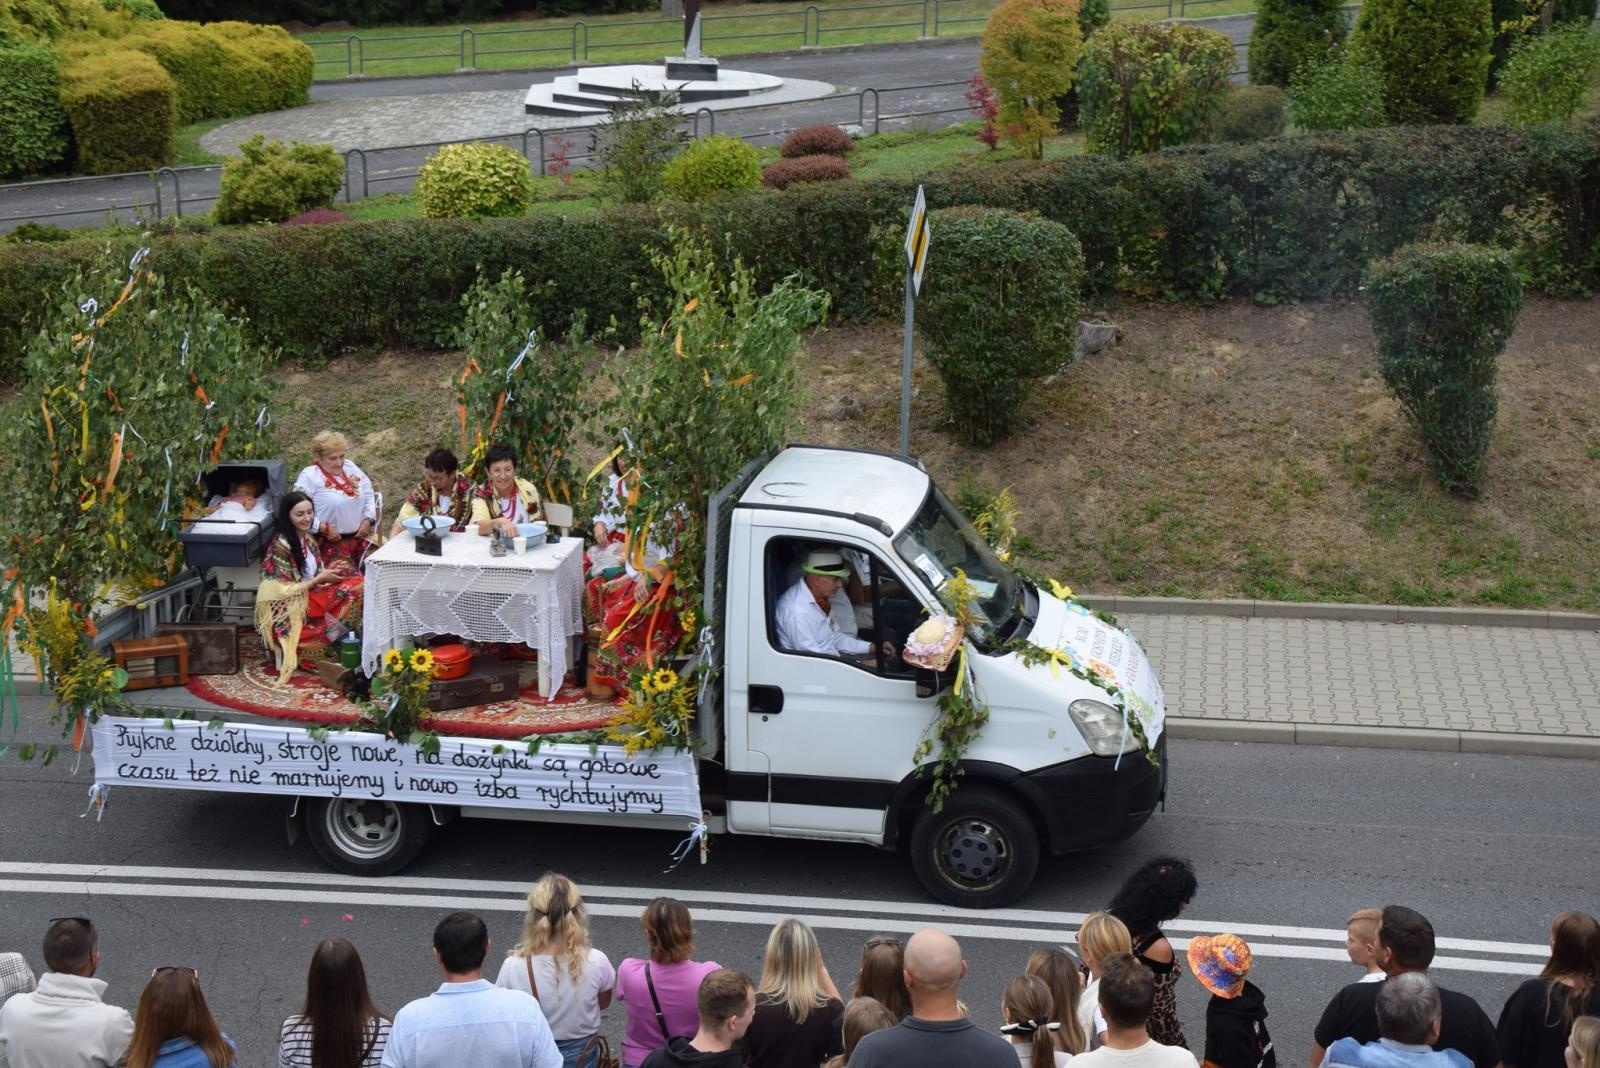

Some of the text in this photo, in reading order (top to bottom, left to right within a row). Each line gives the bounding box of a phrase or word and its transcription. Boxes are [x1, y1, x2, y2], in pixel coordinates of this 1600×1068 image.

[191, 727, 273, 765] dziołchy,
[278, 732, 342, 771] stroje
[351, 741, 404, 766] nowe,
[415, 746, 444, 765] na
[452, 743, 532, 778] dożynki
[542, 757, 569, 778] są
[579, 752, 661, 780] gotowe
[117, 759, 664, 813] czasu też nie marnujemy i nowo izba rychtujymy
